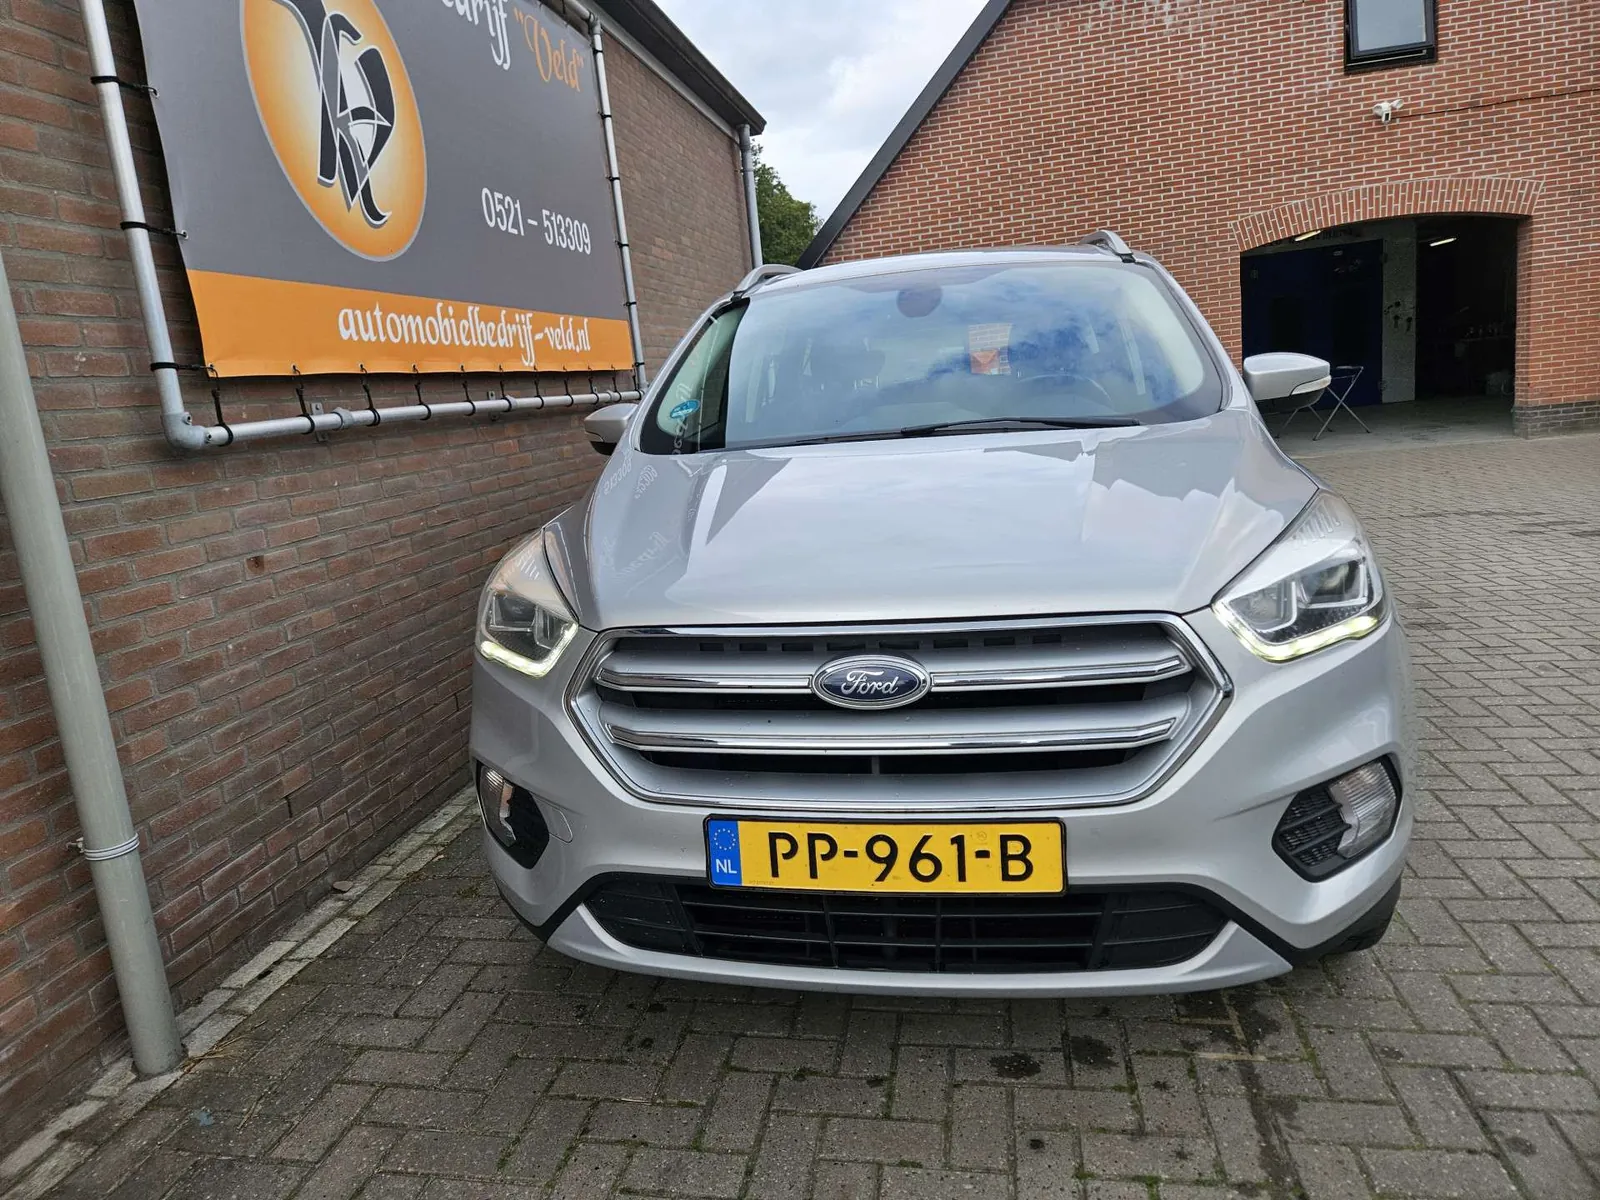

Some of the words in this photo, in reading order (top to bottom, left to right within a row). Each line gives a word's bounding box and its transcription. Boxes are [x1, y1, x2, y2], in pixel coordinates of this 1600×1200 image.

[481, 187, 525, 237] 0521
[541, 208, 592, 255] 513309
[337, 301, 592, 367] automobielbedrijf-veld.nl
[840, 669, 900, 695] Ford
[715, 858, 738, 875] NL
[767, 831, 1035, 883] PP-961-B
